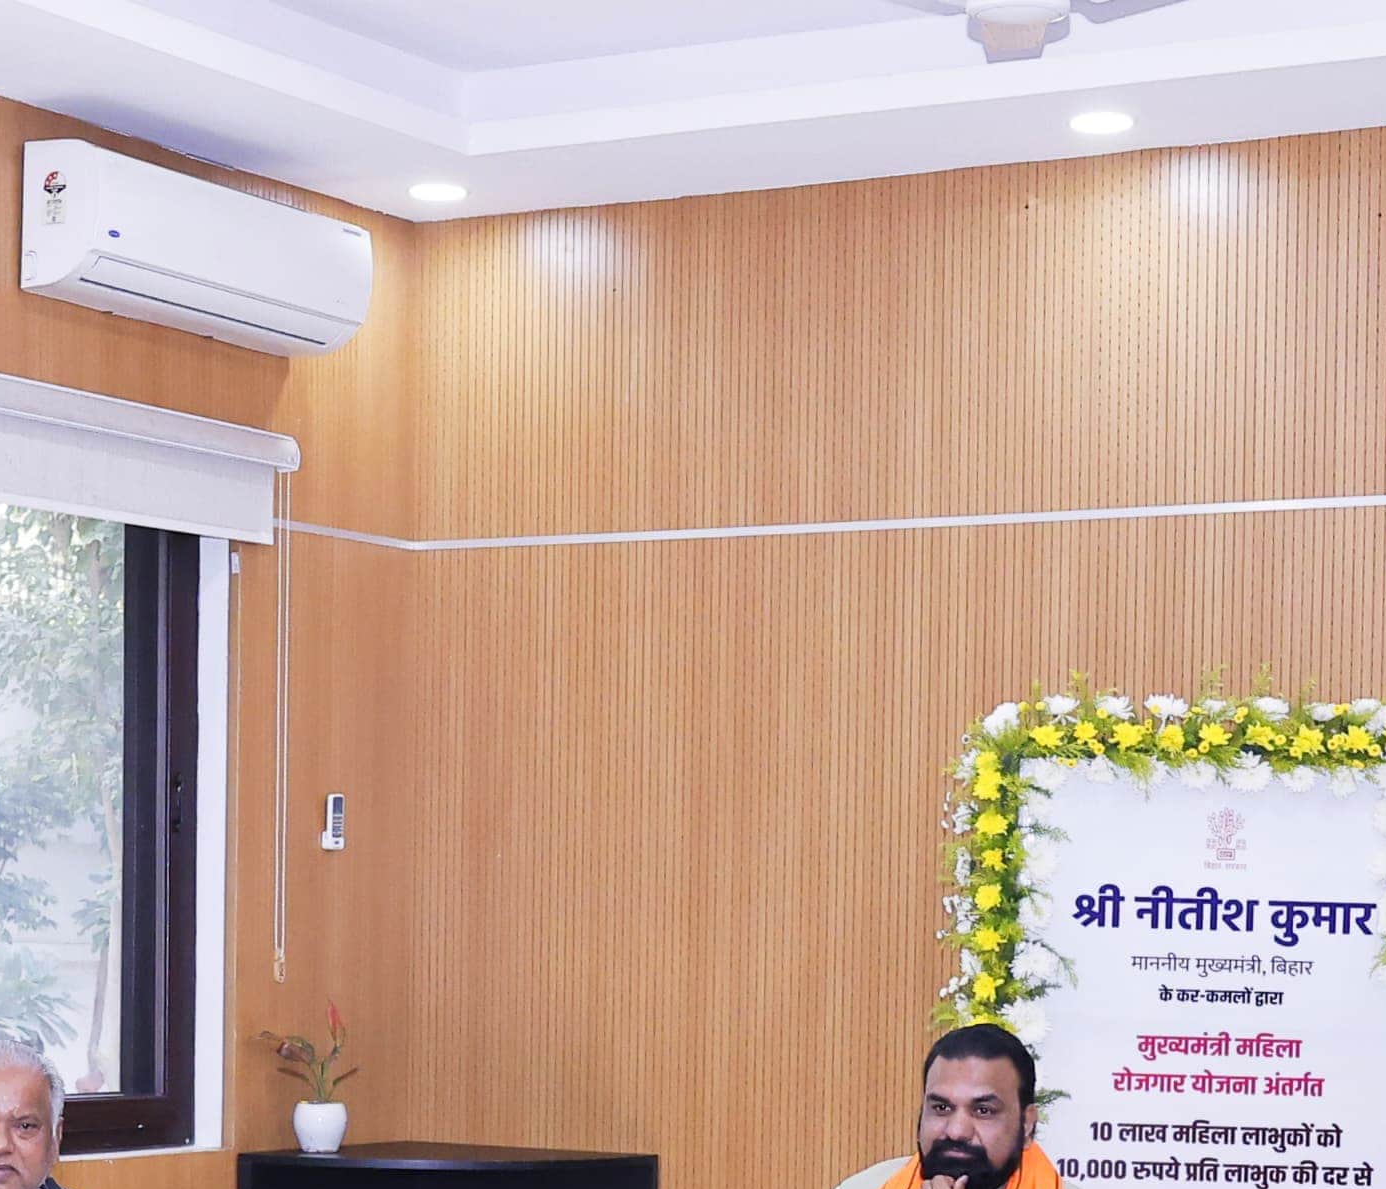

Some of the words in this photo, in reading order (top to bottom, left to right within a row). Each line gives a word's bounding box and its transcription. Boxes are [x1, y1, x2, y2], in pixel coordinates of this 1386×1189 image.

[1072, 884, 1125, 928] श्री
[1134, 886, 1259, 932] नीतीश
[1269, 901, 1377, 947] कुमार
[1131, 952, 1190, 971] माननीय
[1196, 955, 1266, 977] मुख्यमंत्री,
[1271, 956, 1314, 976] बिहार
[1159, 984, 1173, 1001] के
[1176, 987, 1253, 1004] कर-कमलों
[1254, 992, 1284, 1006] द्वारा
[1137, 1032, 1231, 1061] मुख्यमंत्री
[1235, 1033, 1302, 1058] महिला
[1112, 1067, 1187, 1093] रोजगार
[1190, 1069, 1258, 1094] योजना
[1264, 1072, 1325, 1096] अंतर्गत
[1090, 1122, 1112, 1141] 10
[1117, 1123, 1168, 1143] लाख
[1172, 1120, 1237, 1144] महिला
[1241, 1123, 1314, 1153] लाभुकों
[1316, 1123, 1343, 1148] को
[1057, 1160, 1126, 1182] 10,000
[1132, 1156, 1181, 1180] रुपये
[1184, 1157, 1220, 1182] प्रति
[1223, 1164, 1288, 1189] लाभुक
[1292, 1160, 1319, 1185] की
[1322, 1167, 1349, 1185] दर
[1353, 1162, 1373, 1186] से
